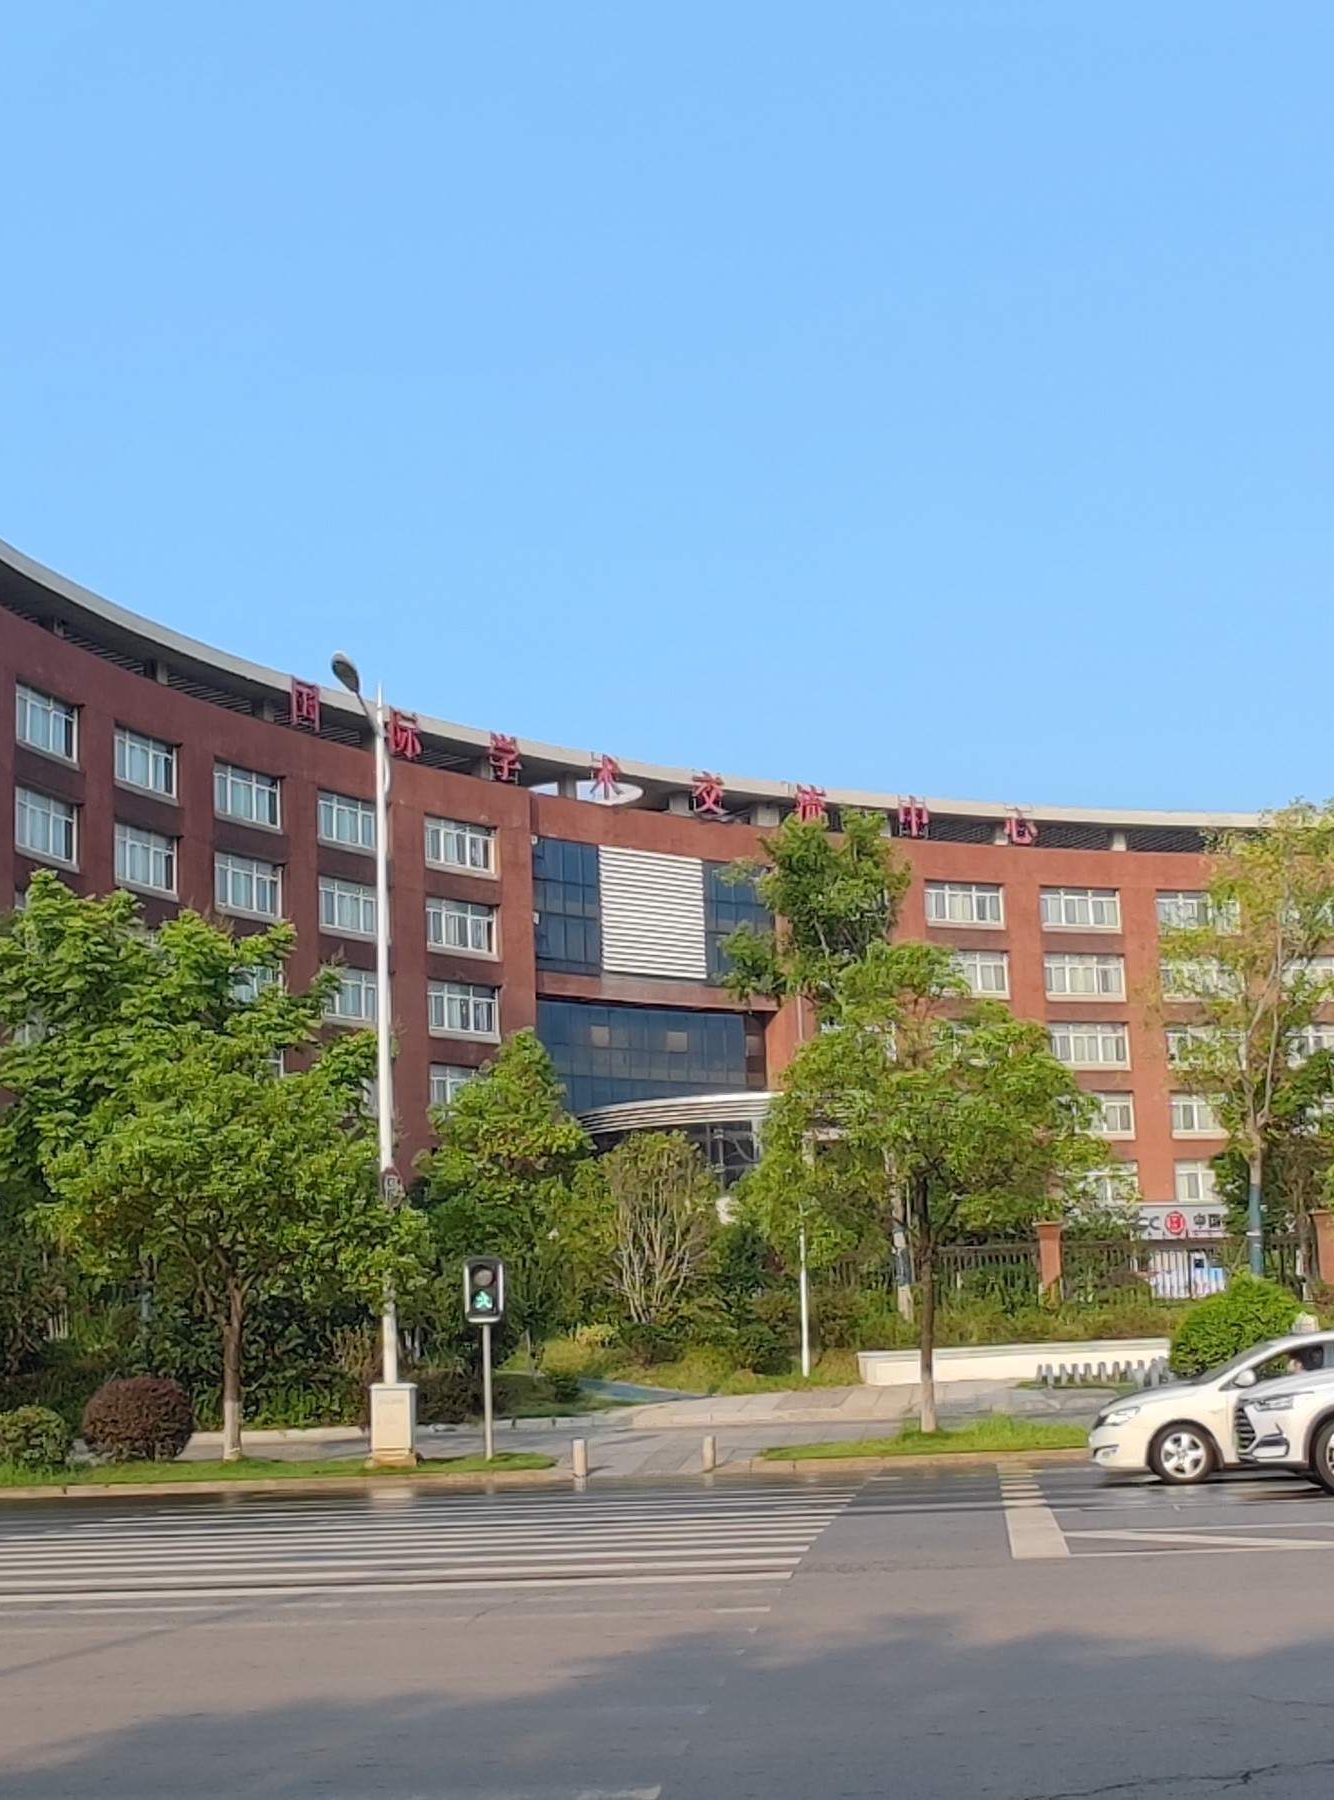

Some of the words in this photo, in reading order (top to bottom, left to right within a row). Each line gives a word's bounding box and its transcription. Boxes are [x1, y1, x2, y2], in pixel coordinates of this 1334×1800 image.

[290, 675, 1038, 845] 国际学术交流中心
